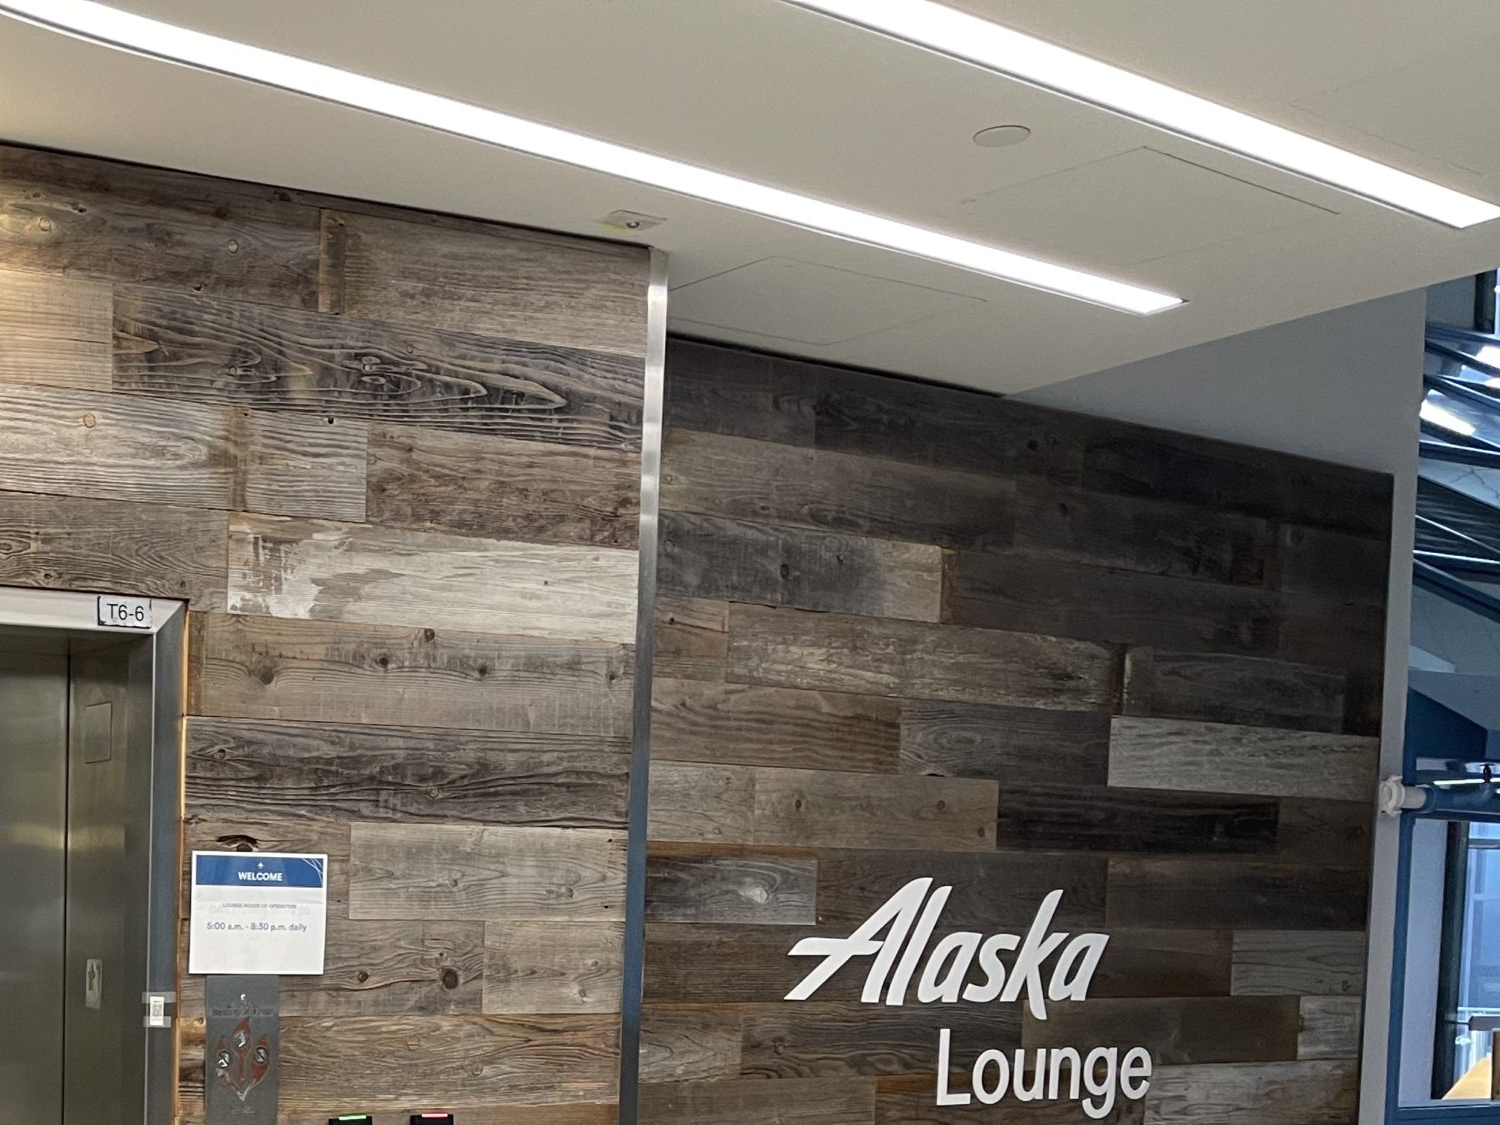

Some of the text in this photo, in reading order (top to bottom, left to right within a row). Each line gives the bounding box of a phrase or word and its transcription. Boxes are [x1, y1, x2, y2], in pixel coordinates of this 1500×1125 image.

[106, 603, 145, 622] T6-6
[238, 871, 283, 882] WELCOME
[206, 921, 226, 931] 5:00
[288, 923, 308, 933] daily
[783, 877, 1110, 1020] Alaska
[936, 1028, 1152, 1120] Lounge
